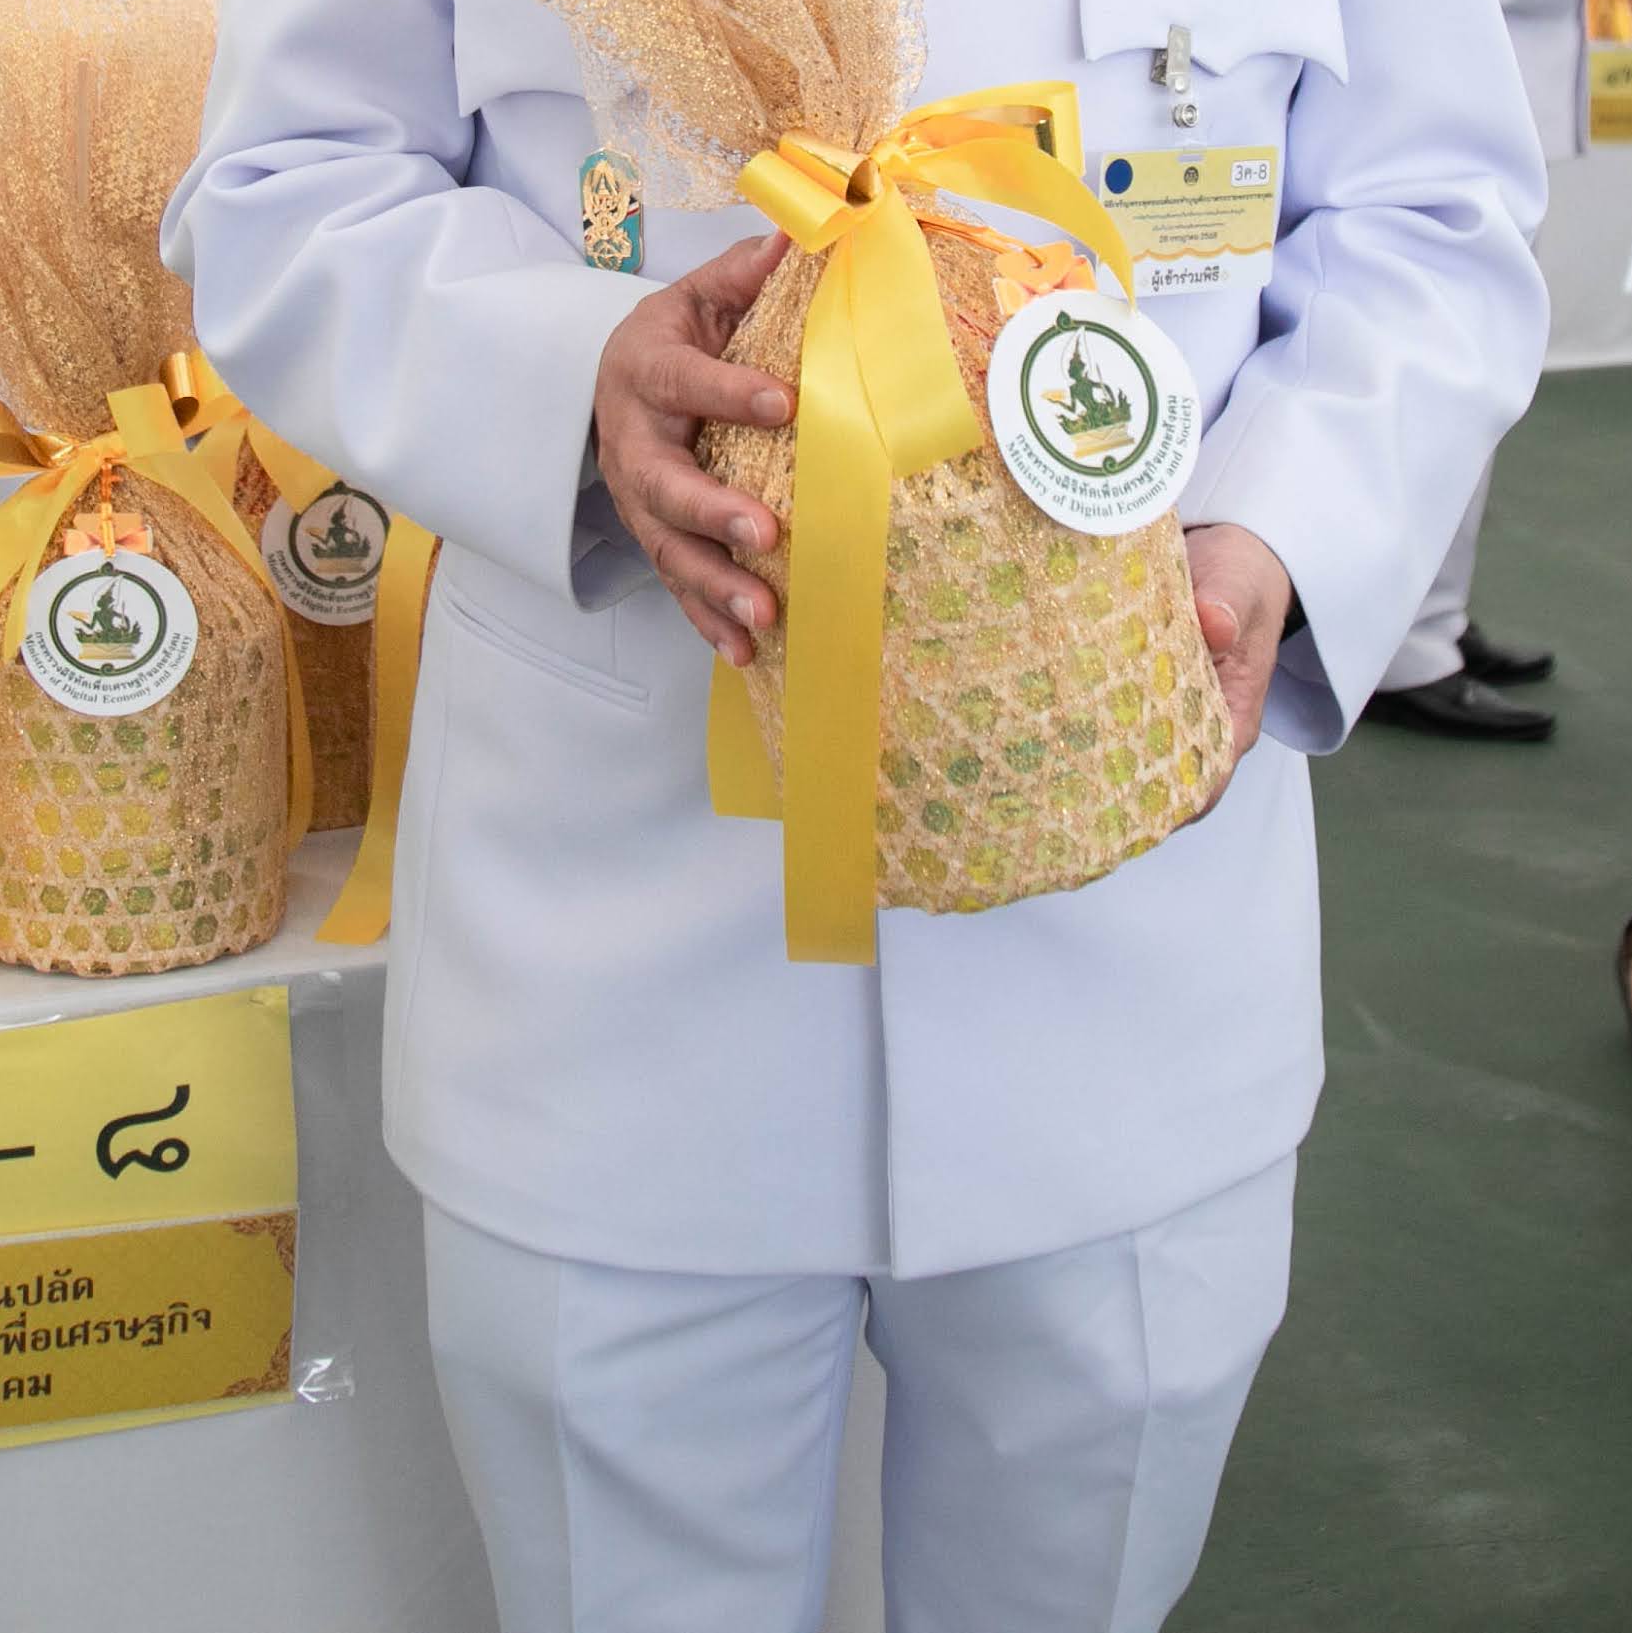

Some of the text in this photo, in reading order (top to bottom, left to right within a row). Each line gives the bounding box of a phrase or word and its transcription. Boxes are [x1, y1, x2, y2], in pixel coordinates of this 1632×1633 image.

[1151, 266, 1221, 292] ผู้เข้าร่วมพิธี
[1005, 397, 1195, 518] Ministry of Digital Economy and Society
[25, 633, 192, 704] Ministry of Digital Economy and Society
[97, 1084, 191, 1180] ๘
